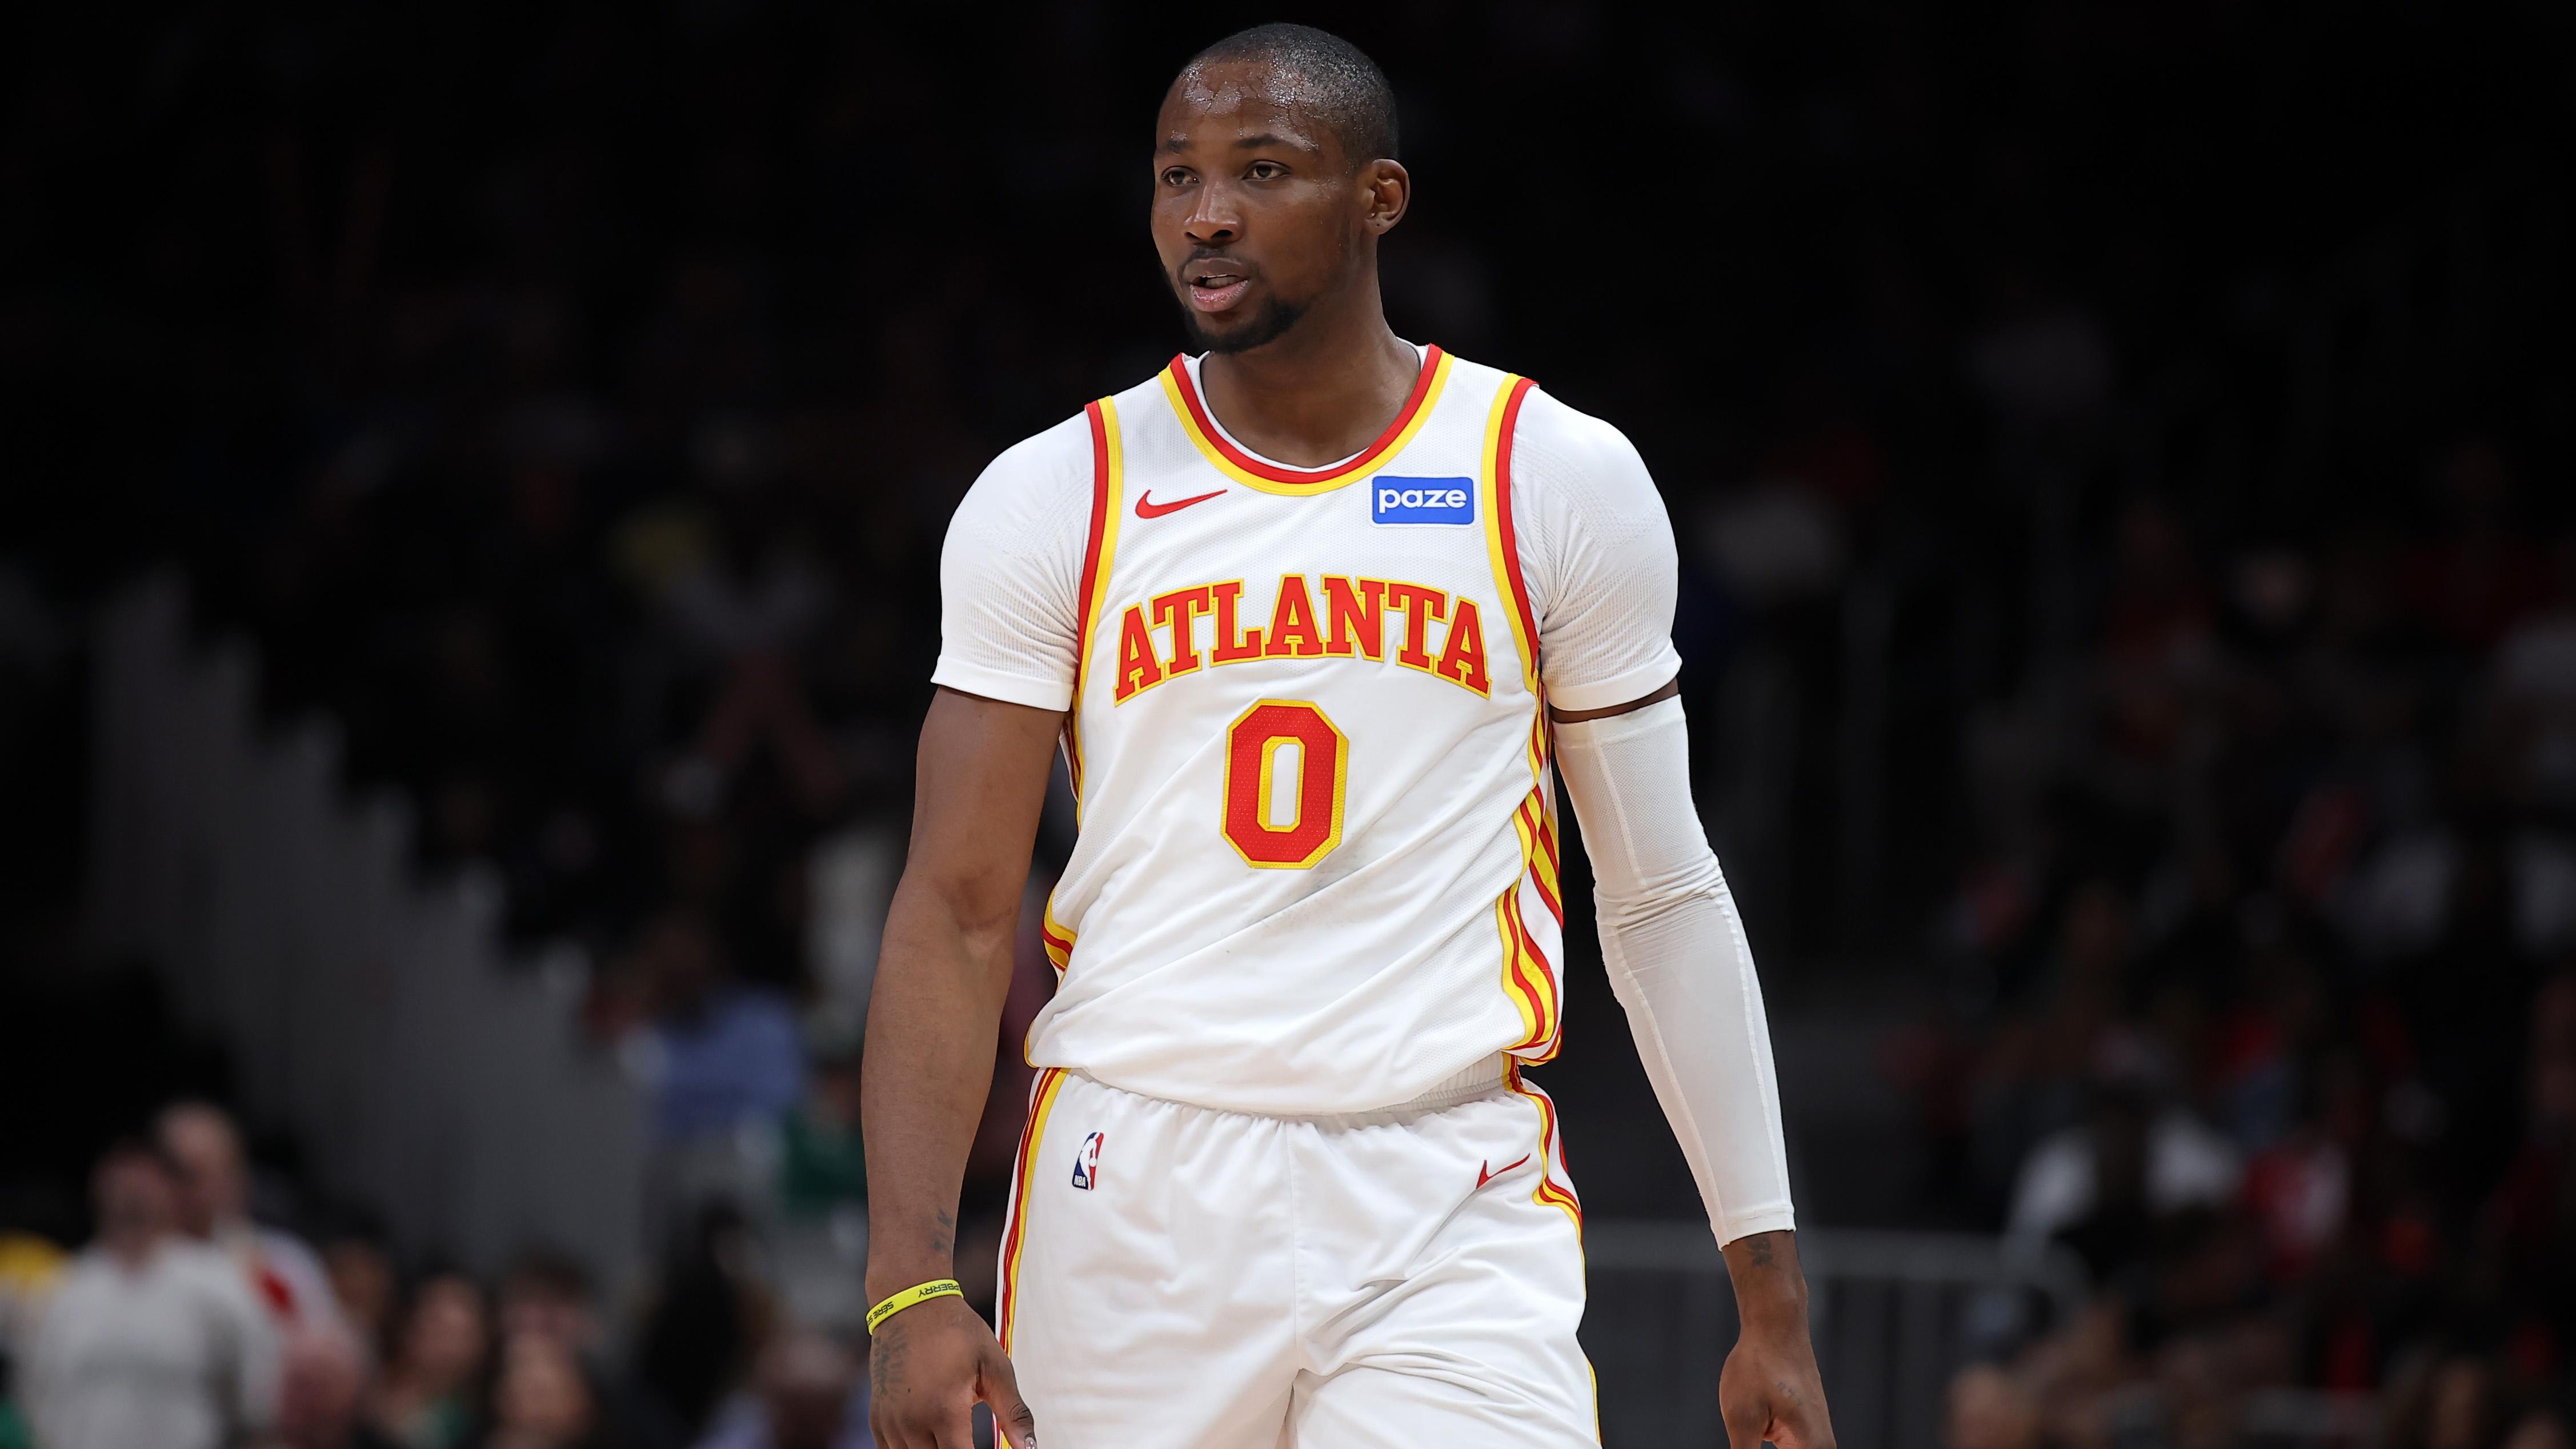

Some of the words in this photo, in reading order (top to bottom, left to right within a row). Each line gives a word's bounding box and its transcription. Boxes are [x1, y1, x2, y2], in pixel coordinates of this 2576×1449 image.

[1379, 489, 1468, 514] paze
[1113, 574, 1492, 707] ATLANTA
[1220, 698, 1349, 870] 0
[1074, 1175, 1086, 1187] NBA
